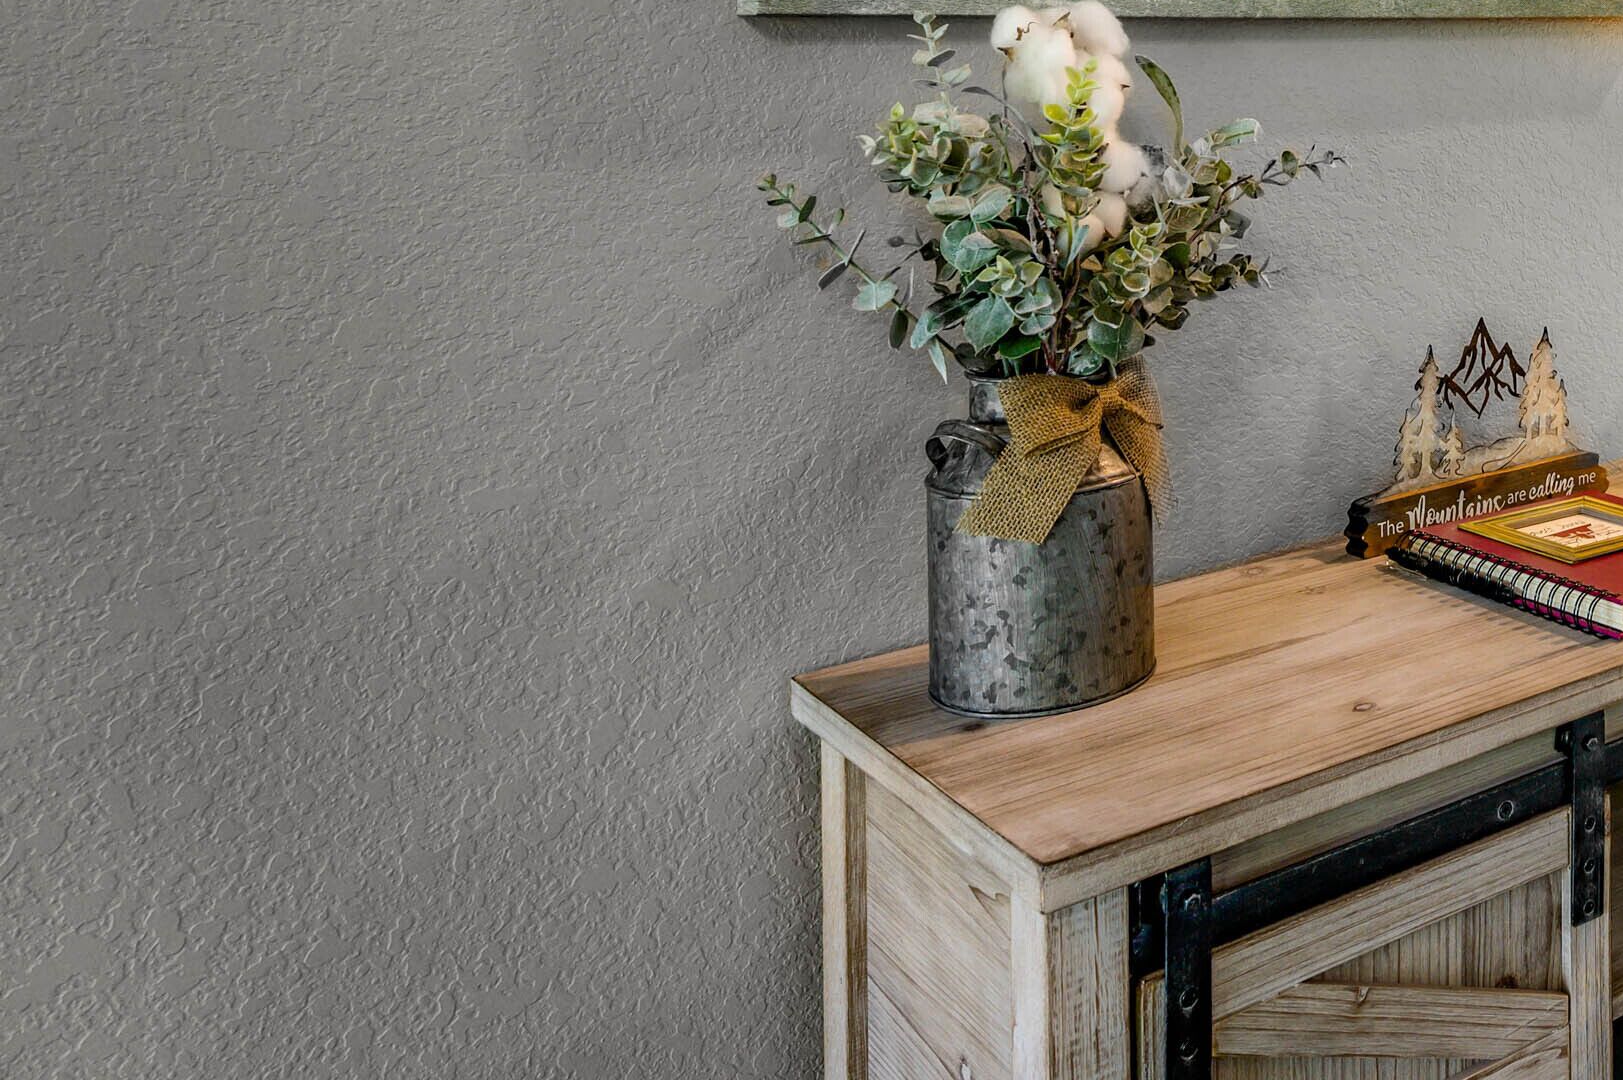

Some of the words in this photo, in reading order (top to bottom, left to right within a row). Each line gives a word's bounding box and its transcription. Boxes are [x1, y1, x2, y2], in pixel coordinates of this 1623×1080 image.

[1376, 519, 1405, 539] The
[1405, 489, 1506, 532] Mountains
[1507, 488, 1527, 505] are
[1528, 471, 1576, 501] calling
[1577, 471, 1597, 487] me
